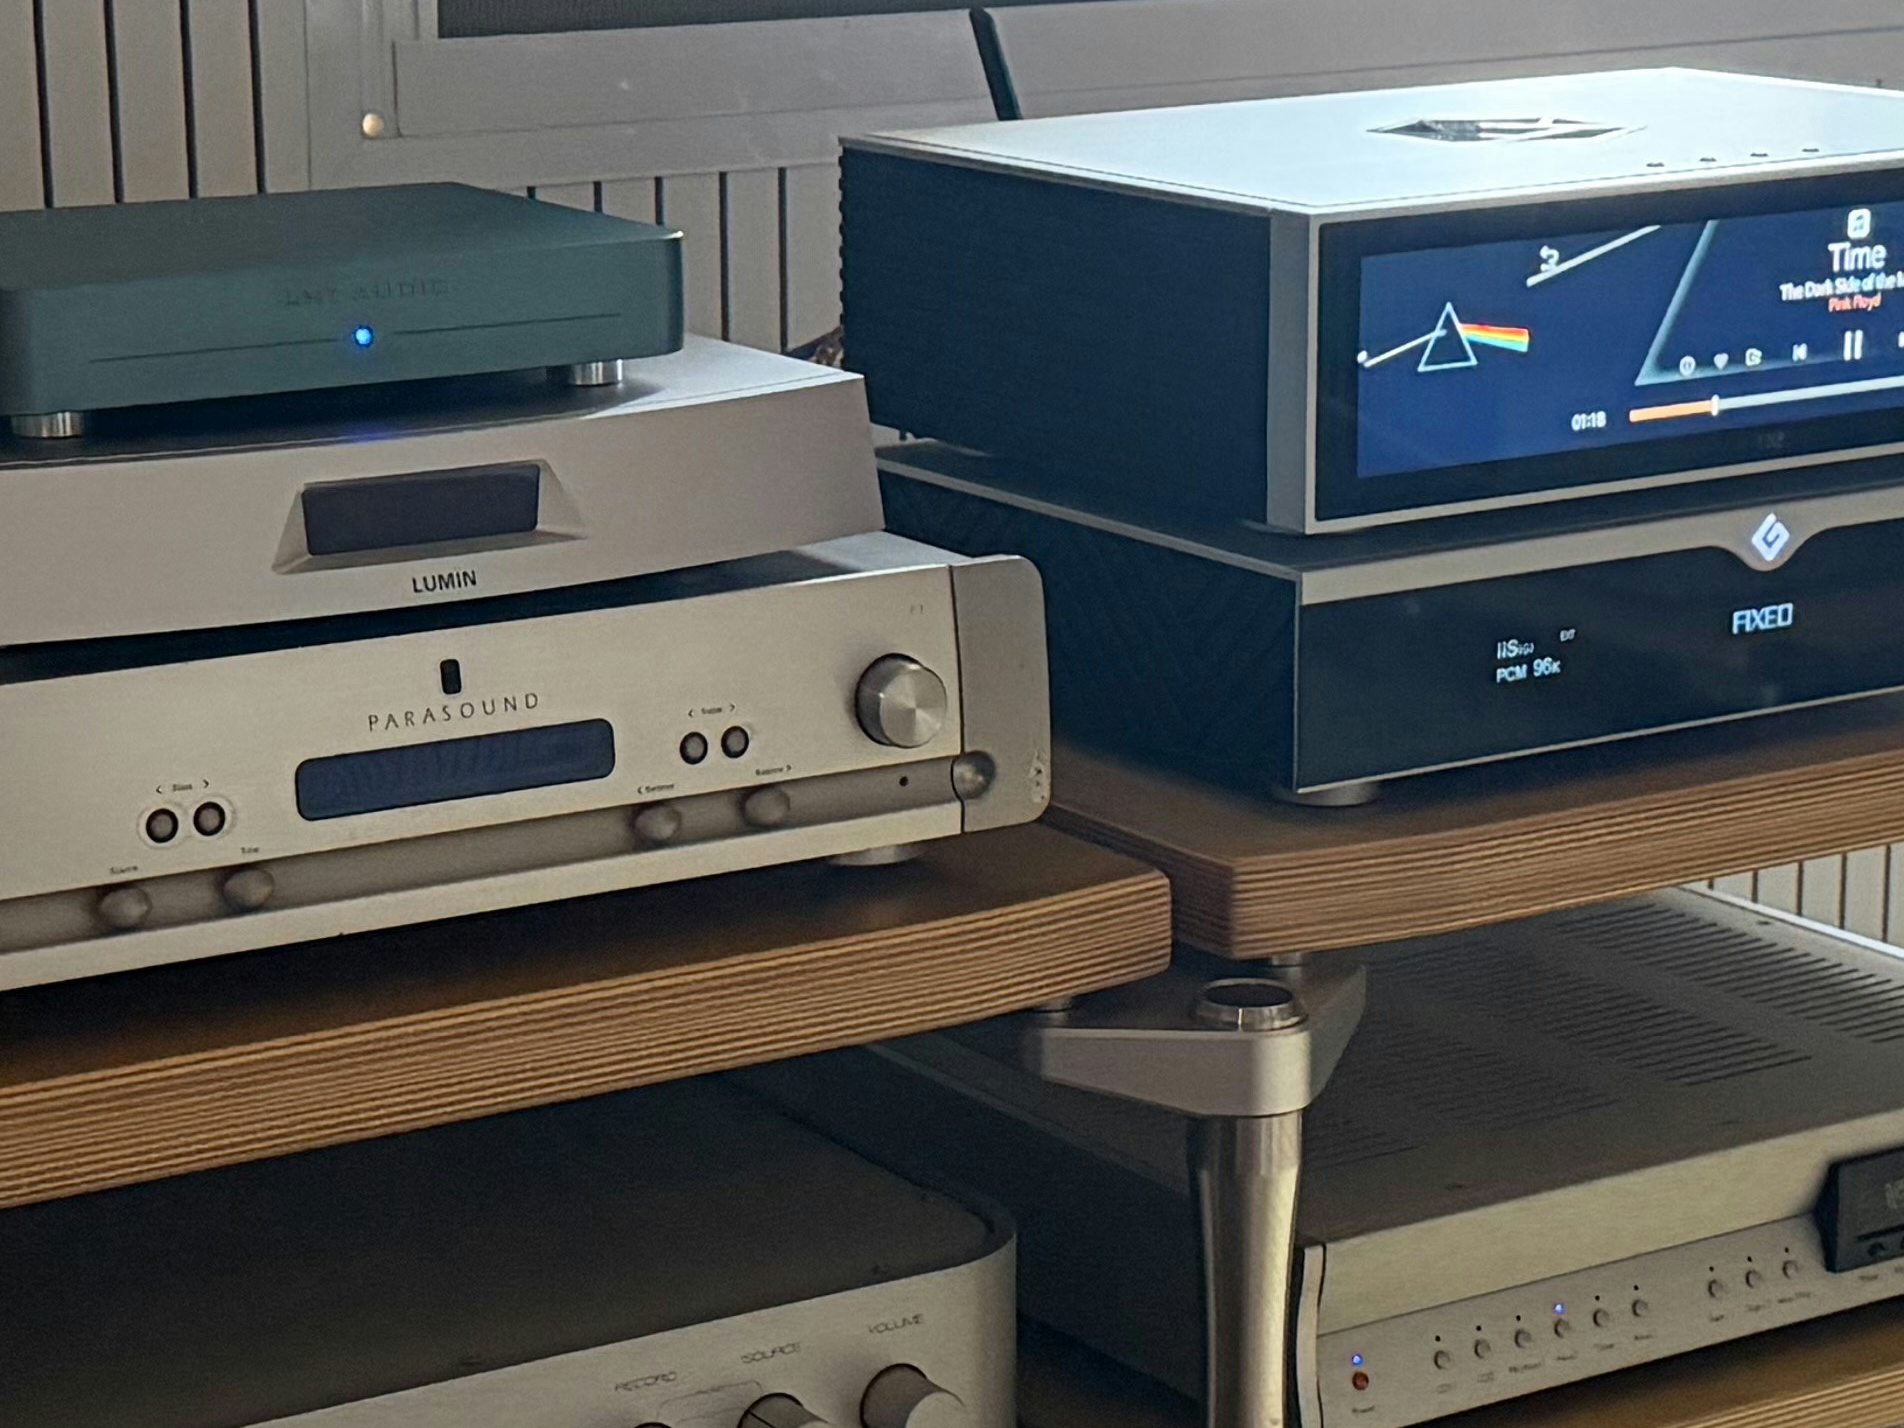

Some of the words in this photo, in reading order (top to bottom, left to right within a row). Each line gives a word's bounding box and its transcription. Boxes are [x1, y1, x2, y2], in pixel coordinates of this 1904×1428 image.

[1828, 242, 1887, 272] Time
[1779, 282, 1804, 301] The
[1804, 278, 1833, 298] Dark
[1834, 275, 1861, 295] Side
[1861, 273, 1876, 292] of
[1875, 271, 1895, 290] the
[1828, 295, 1852, 313] Pink
[1853, 292, 1882, 312] Floyd
[1571, 410, 1607, 431] 01:18
[412, 569, 477, 594] LUMIN
[1732, 602, 1794, 636] FIXED
[1496, 663, 1528, 684] PCM
[367, 692, 539, 732] PARASOUND
[867, 1313, 925, 1334] VOLUME
[740, 1341, 802, 1365] SOURCE
[614, 1371, 678, 1392] RECORD
